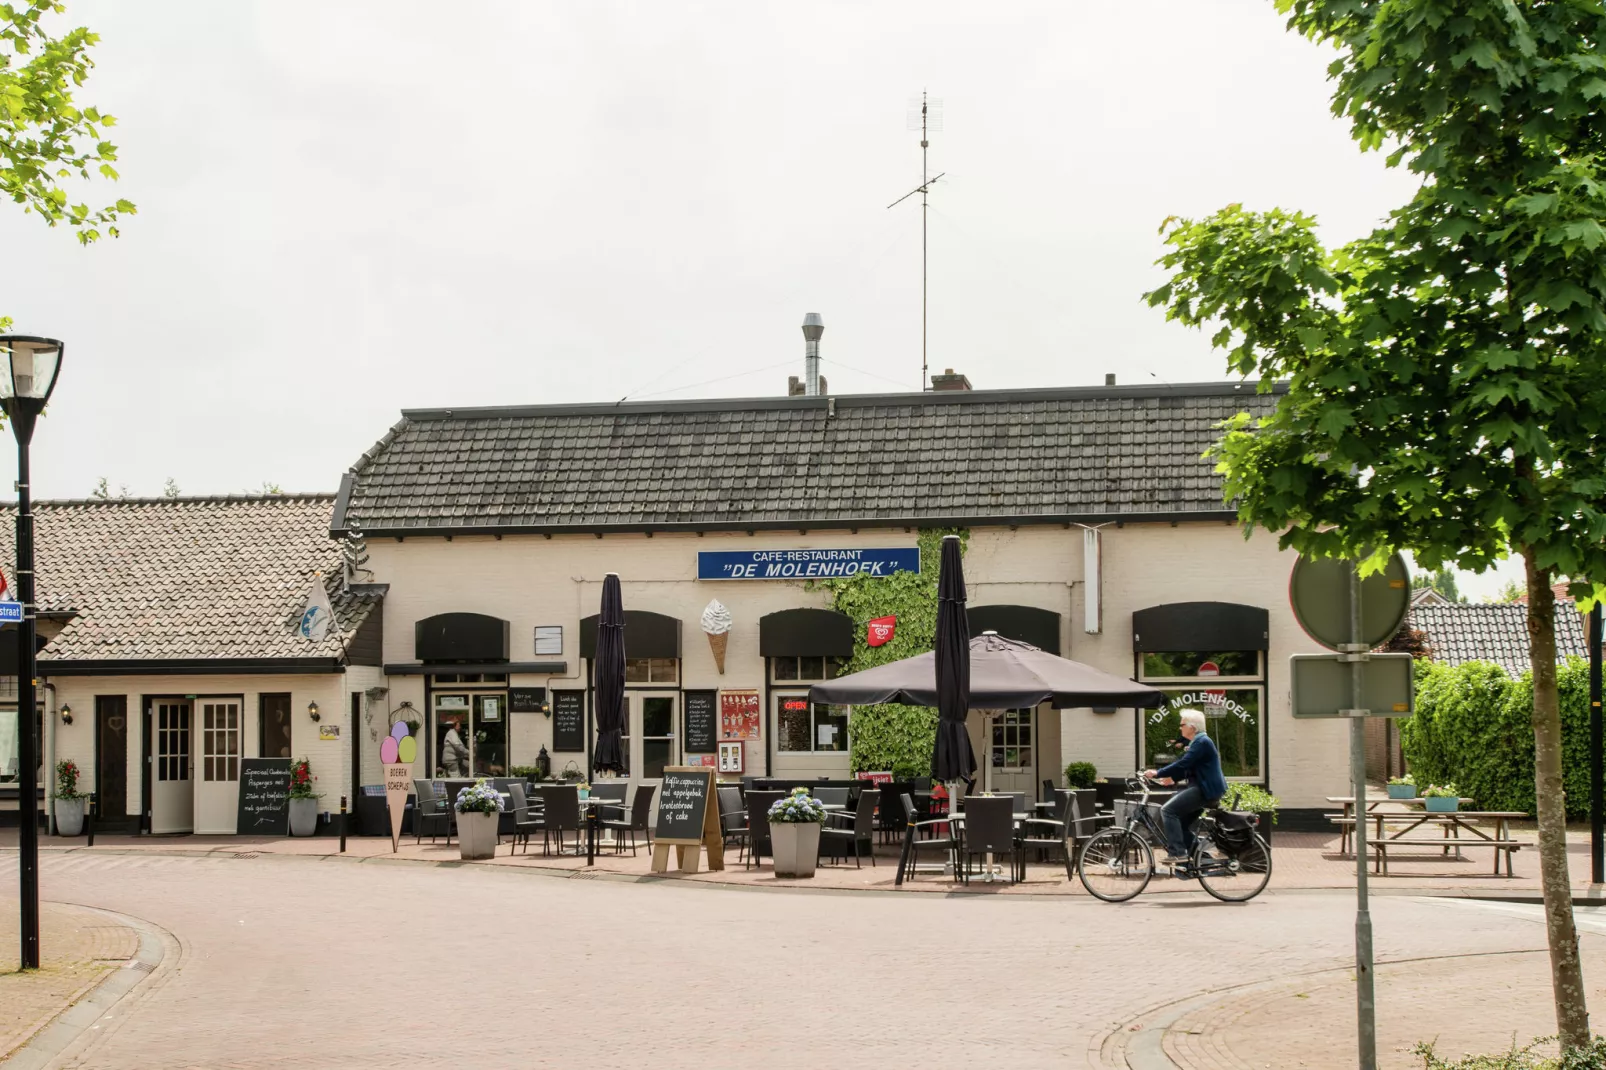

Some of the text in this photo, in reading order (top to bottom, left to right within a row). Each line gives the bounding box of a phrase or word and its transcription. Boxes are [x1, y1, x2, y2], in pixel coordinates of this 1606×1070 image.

[753, 550, 863, 562] CAFE-RESTAURANT
[0, 606, 20, 617] straat
[784, 701, 807, 710] OPEN
[390, 768, 408, 777] BOEREN
[248, 779, 273, 789] Asperges
[665, 810, 688, 824] of cake
